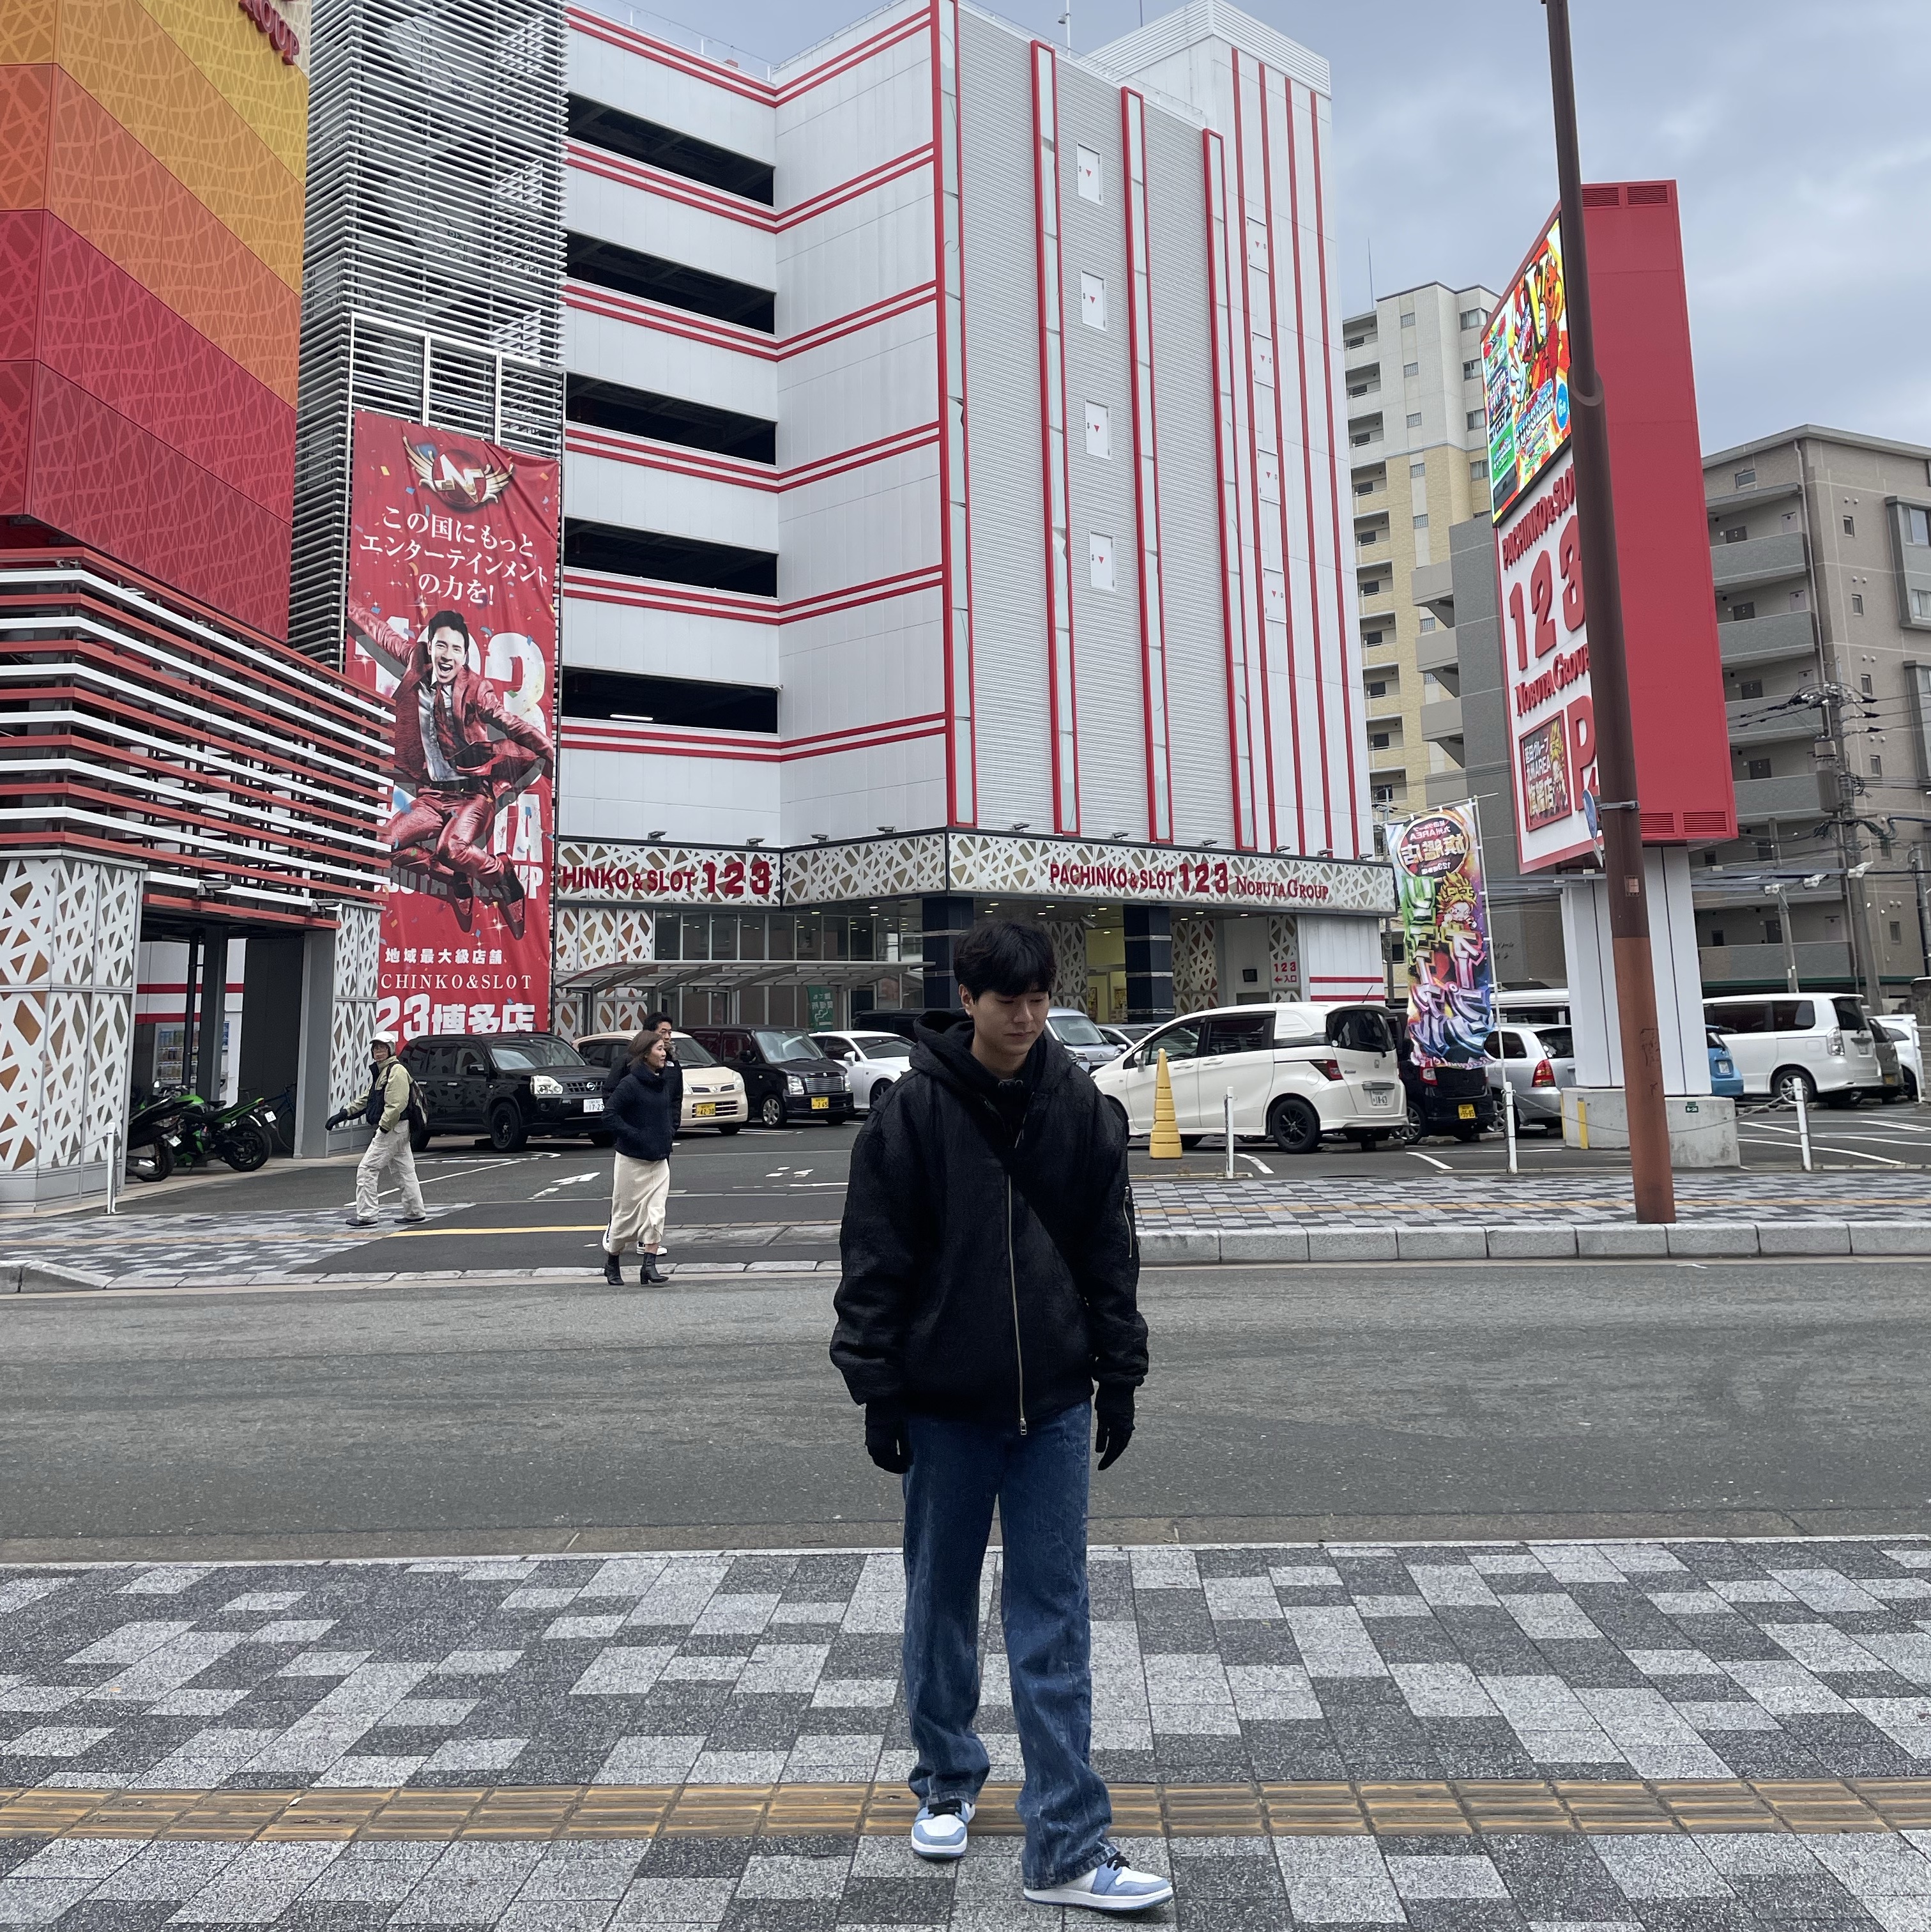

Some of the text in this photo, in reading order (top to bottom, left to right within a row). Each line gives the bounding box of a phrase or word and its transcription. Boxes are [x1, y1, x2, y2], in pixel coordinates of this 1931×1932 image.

[383, 506, 534, 558] この国にもっと
[1502, 463, 1576, 571] PACHINKO&SLO
[360, 535, 547, 588] エンターテインメント
[703, 861, 771, 895] 123
[1179, 862, 1229, 894] 123
[1288, 879, 1329, 900] GROUP
[385, 947, 503, 965] 地域最大級店舗
[1274, 961, 1296, 972] 123
[1284, 975, 1297, 983] 入口
